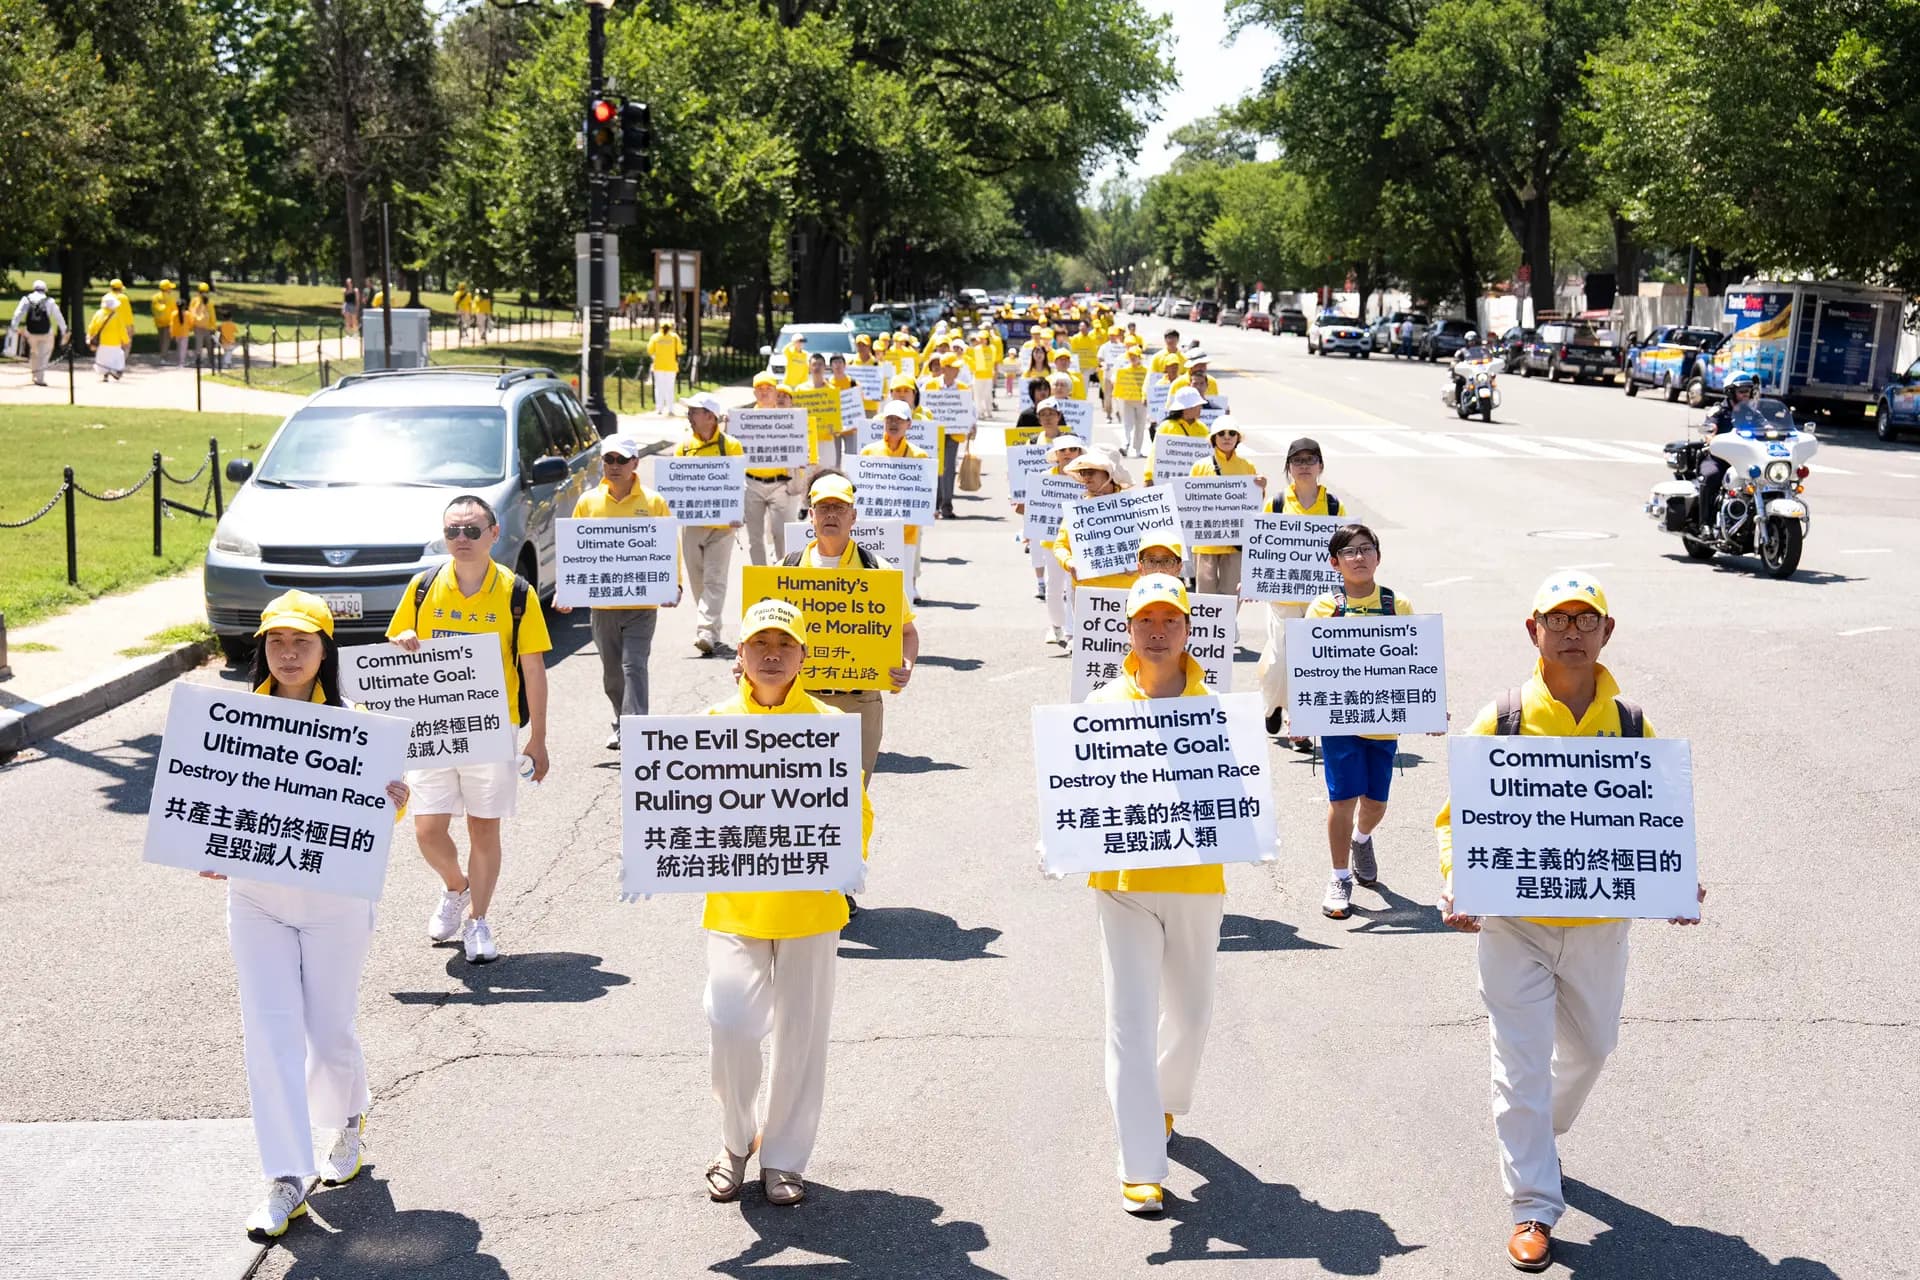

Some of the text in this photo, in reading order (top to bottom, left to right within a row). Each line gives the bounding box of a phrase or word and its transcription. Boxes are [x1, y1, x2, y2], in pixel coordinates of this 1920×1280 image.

[669, 462, 730, 470] Communism's
[860, 461, 922, 470] Communism's
[859, 472, 921, 481] Ultimate Goal:
[1185, 480, 1247, 489] Communism's
[669, 499, 738, 508] 產主義的終極目的
[857, 497, 930, 509] 產主義的終極目的
[1030, 500, 1056, 509] Destroy
[1041, 490, 1078, 500] Ultimate
[1073, 492, 1164, 516] The Evil Specter
[1185, 492, 1247, 500] Ultimate Goal:
[1073, 519, 1085, 529] of
[1087, 508, 1159, 527] Communism
[1161, 505, 1170, 513] Is
[1254, 520, 1277, 530] The
[1280, 521, 1300, 531] Evil
[577, 524, 656, 534] Communism's
[1075, 516, 1174, 542] Ruling Our World
[577, 538, 656, 549] Ultimate Goal:
[1083, 538, 1141, 558] 共產主義邪
[1250, 534, 1329, 548] of Communis
[563, 556, 597, 564] Destroy
[1090, 553, 1138, 570] 統治我們
[1249, 549, 1312, 562] Ruling Our
[566, 571, 670, 584] 共產主義的終極目的
[589, 585, 646, 598] 是毀滅人類
[802, 598, 847, 615] Hope
[852, 600, 863, 614] Is
[869, 601, 885, 614] to
[1090, 597, 1222, 618] The cter
[826, 620, 892, 638] Morality
[1083, 618, 1225, 639] of Is
[1312, 624, 1417, 639] Communism's
[357, 646, 473, 669] Communism's
[1312, 643, 1418, 658] Ultimate Goal:
[359, 667, 476, 691] Ultimate Goal:
[799, 666, 879, 681] 才有出路
[1294, 664, 1438, 678] Destroy the Human Race
[365, 689, 499, 711] troy the Human Race
[1298, 688, 1436, 706] 共產主義的終極目的
[209, 702, 368, 746] Communism's
[410, 714, 500, 738] 的終極目的
[1073, 708, 1227, 733] Communism's
[1329, 708, 1406, 724] 是毀滅人類
[641, 729, 840, 752] The Evil Specter
[1075, 734, 1230, 761] Ultimate Goal:
[203, 732, 364, 776] Ultimate Goal:
[1489, 748, 1651, 769] Communism's
[634, 758, 848, 781] of Communism Is
[1049, 763, 1260, 790] Destroy the Human Race
[168, 759, 386, 809] Destroy the Human Race
[1490, 778, 1653, 799] Ultimate Goal:
[635, 787, 849, 814] Ruling Our World
[1056, 796, 1260, 830] 共產主義的終極目的
[1462, 810, 1684, 828] Destroy the Human Race
[164, 797, 375, 853] 共產主義的終極目的
[644, 824, 841, 850] 共產主義魔鬼正在
[1103, 826, 1218, 854] 是毀滅人類
[205, 833, 324, 874] 是毀滅人類
[1467, 846, 1682, 872] 共產主義的終極目的
[656, 852, 830, 878] 統治我們的世界
[1516, 876, 1636, 900] 是毀滅人類
